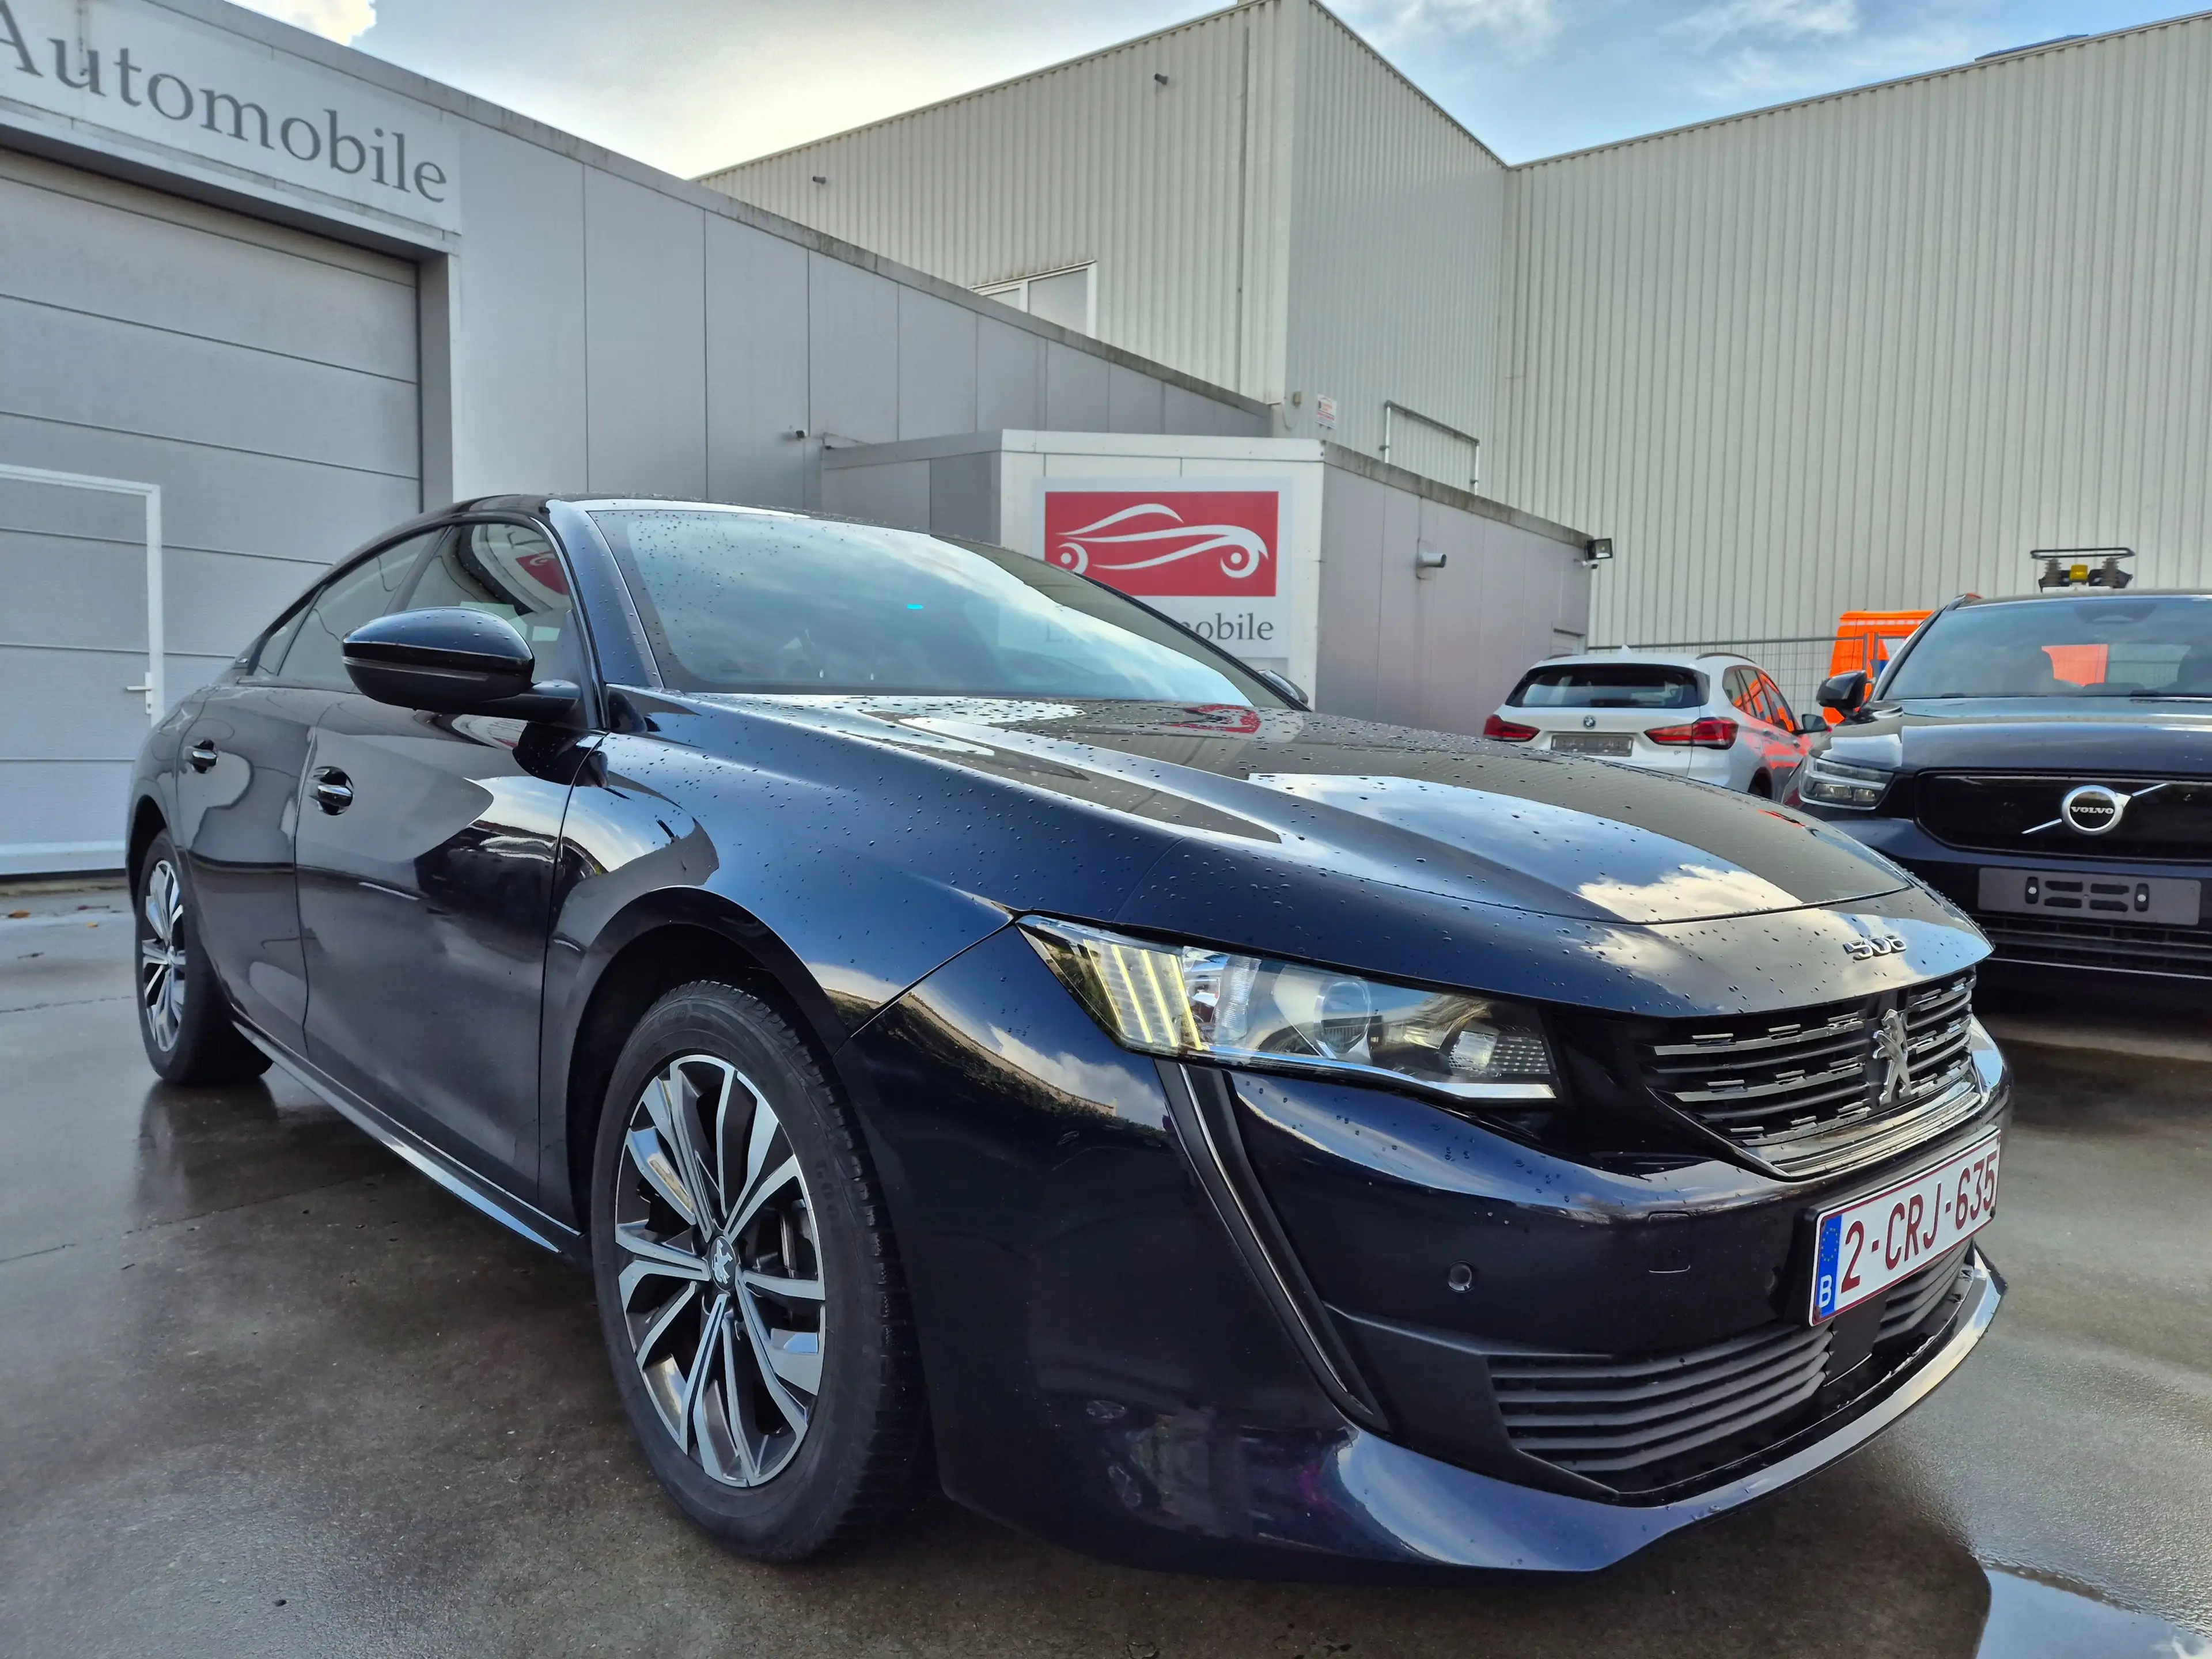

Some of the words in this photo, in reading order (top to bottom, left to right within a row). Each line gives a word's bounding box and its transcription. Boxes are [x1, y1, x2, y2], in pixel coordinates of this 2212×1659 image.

[1843, 934, 1907, 960] 508
[1841, 1153, 1997, 1293] 2-CRJ-635
[1819, 1274, 1832, 1308] B
